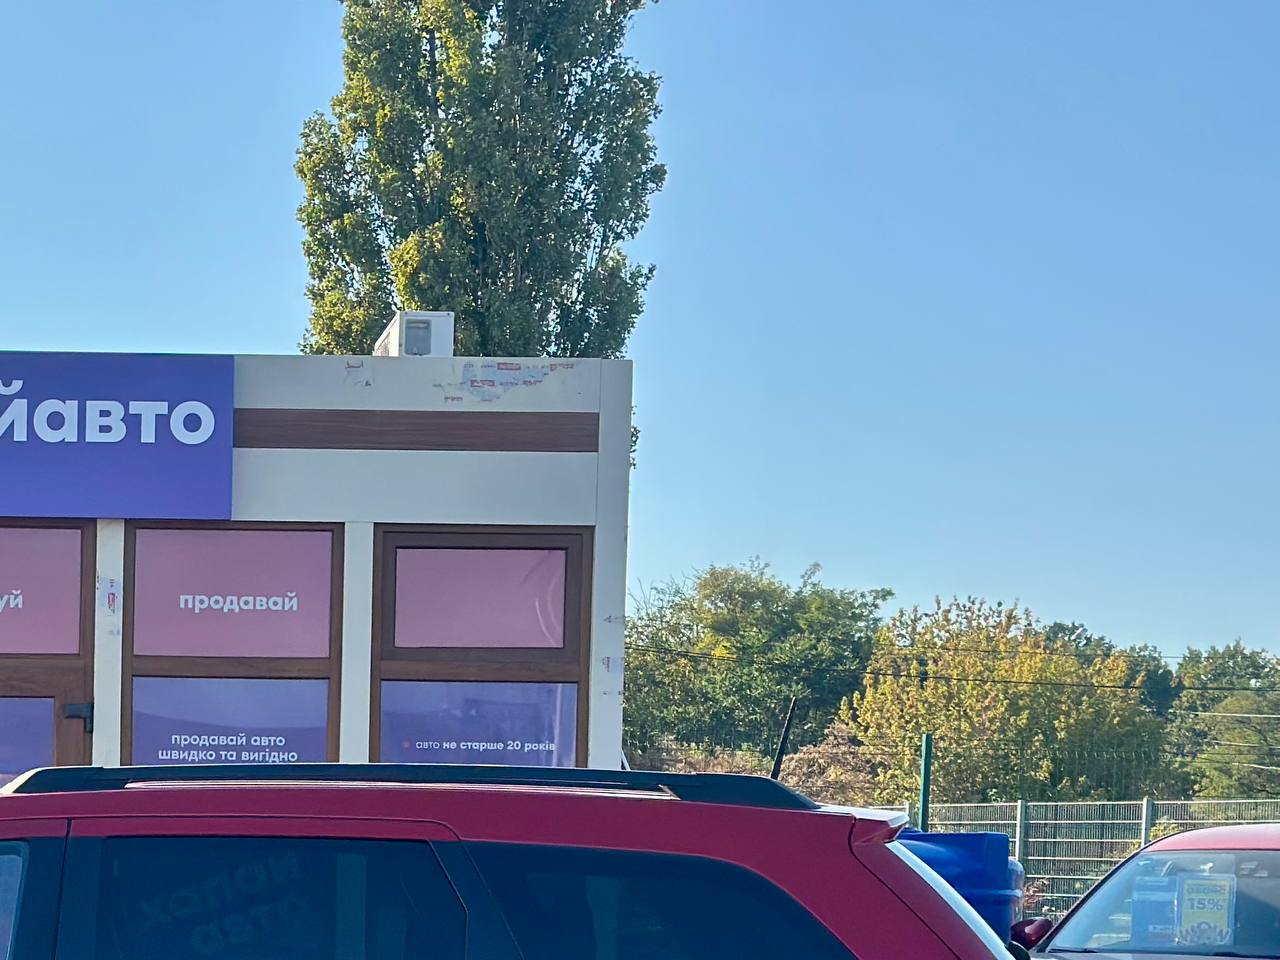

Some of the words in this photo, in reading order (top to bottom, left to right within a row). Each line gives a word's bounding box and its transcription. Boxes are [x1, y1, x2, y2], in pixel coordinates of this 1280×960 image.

[179, 591, 299, 613] продавай
[171, 733, 246, 747] продавай
[251, 736, 286, 746] авто
[415, 741, 440, 749] авто
[443, 741, 457, 750] не
[460, 741, 504, 751] старше
[507, 741, 521, 750] 20
[524, 740, 556, 752] років
[158, 750, 216, 762] швидко
[220, 751, 237, 760] та
[241, 749, 298, 763] вигідно
